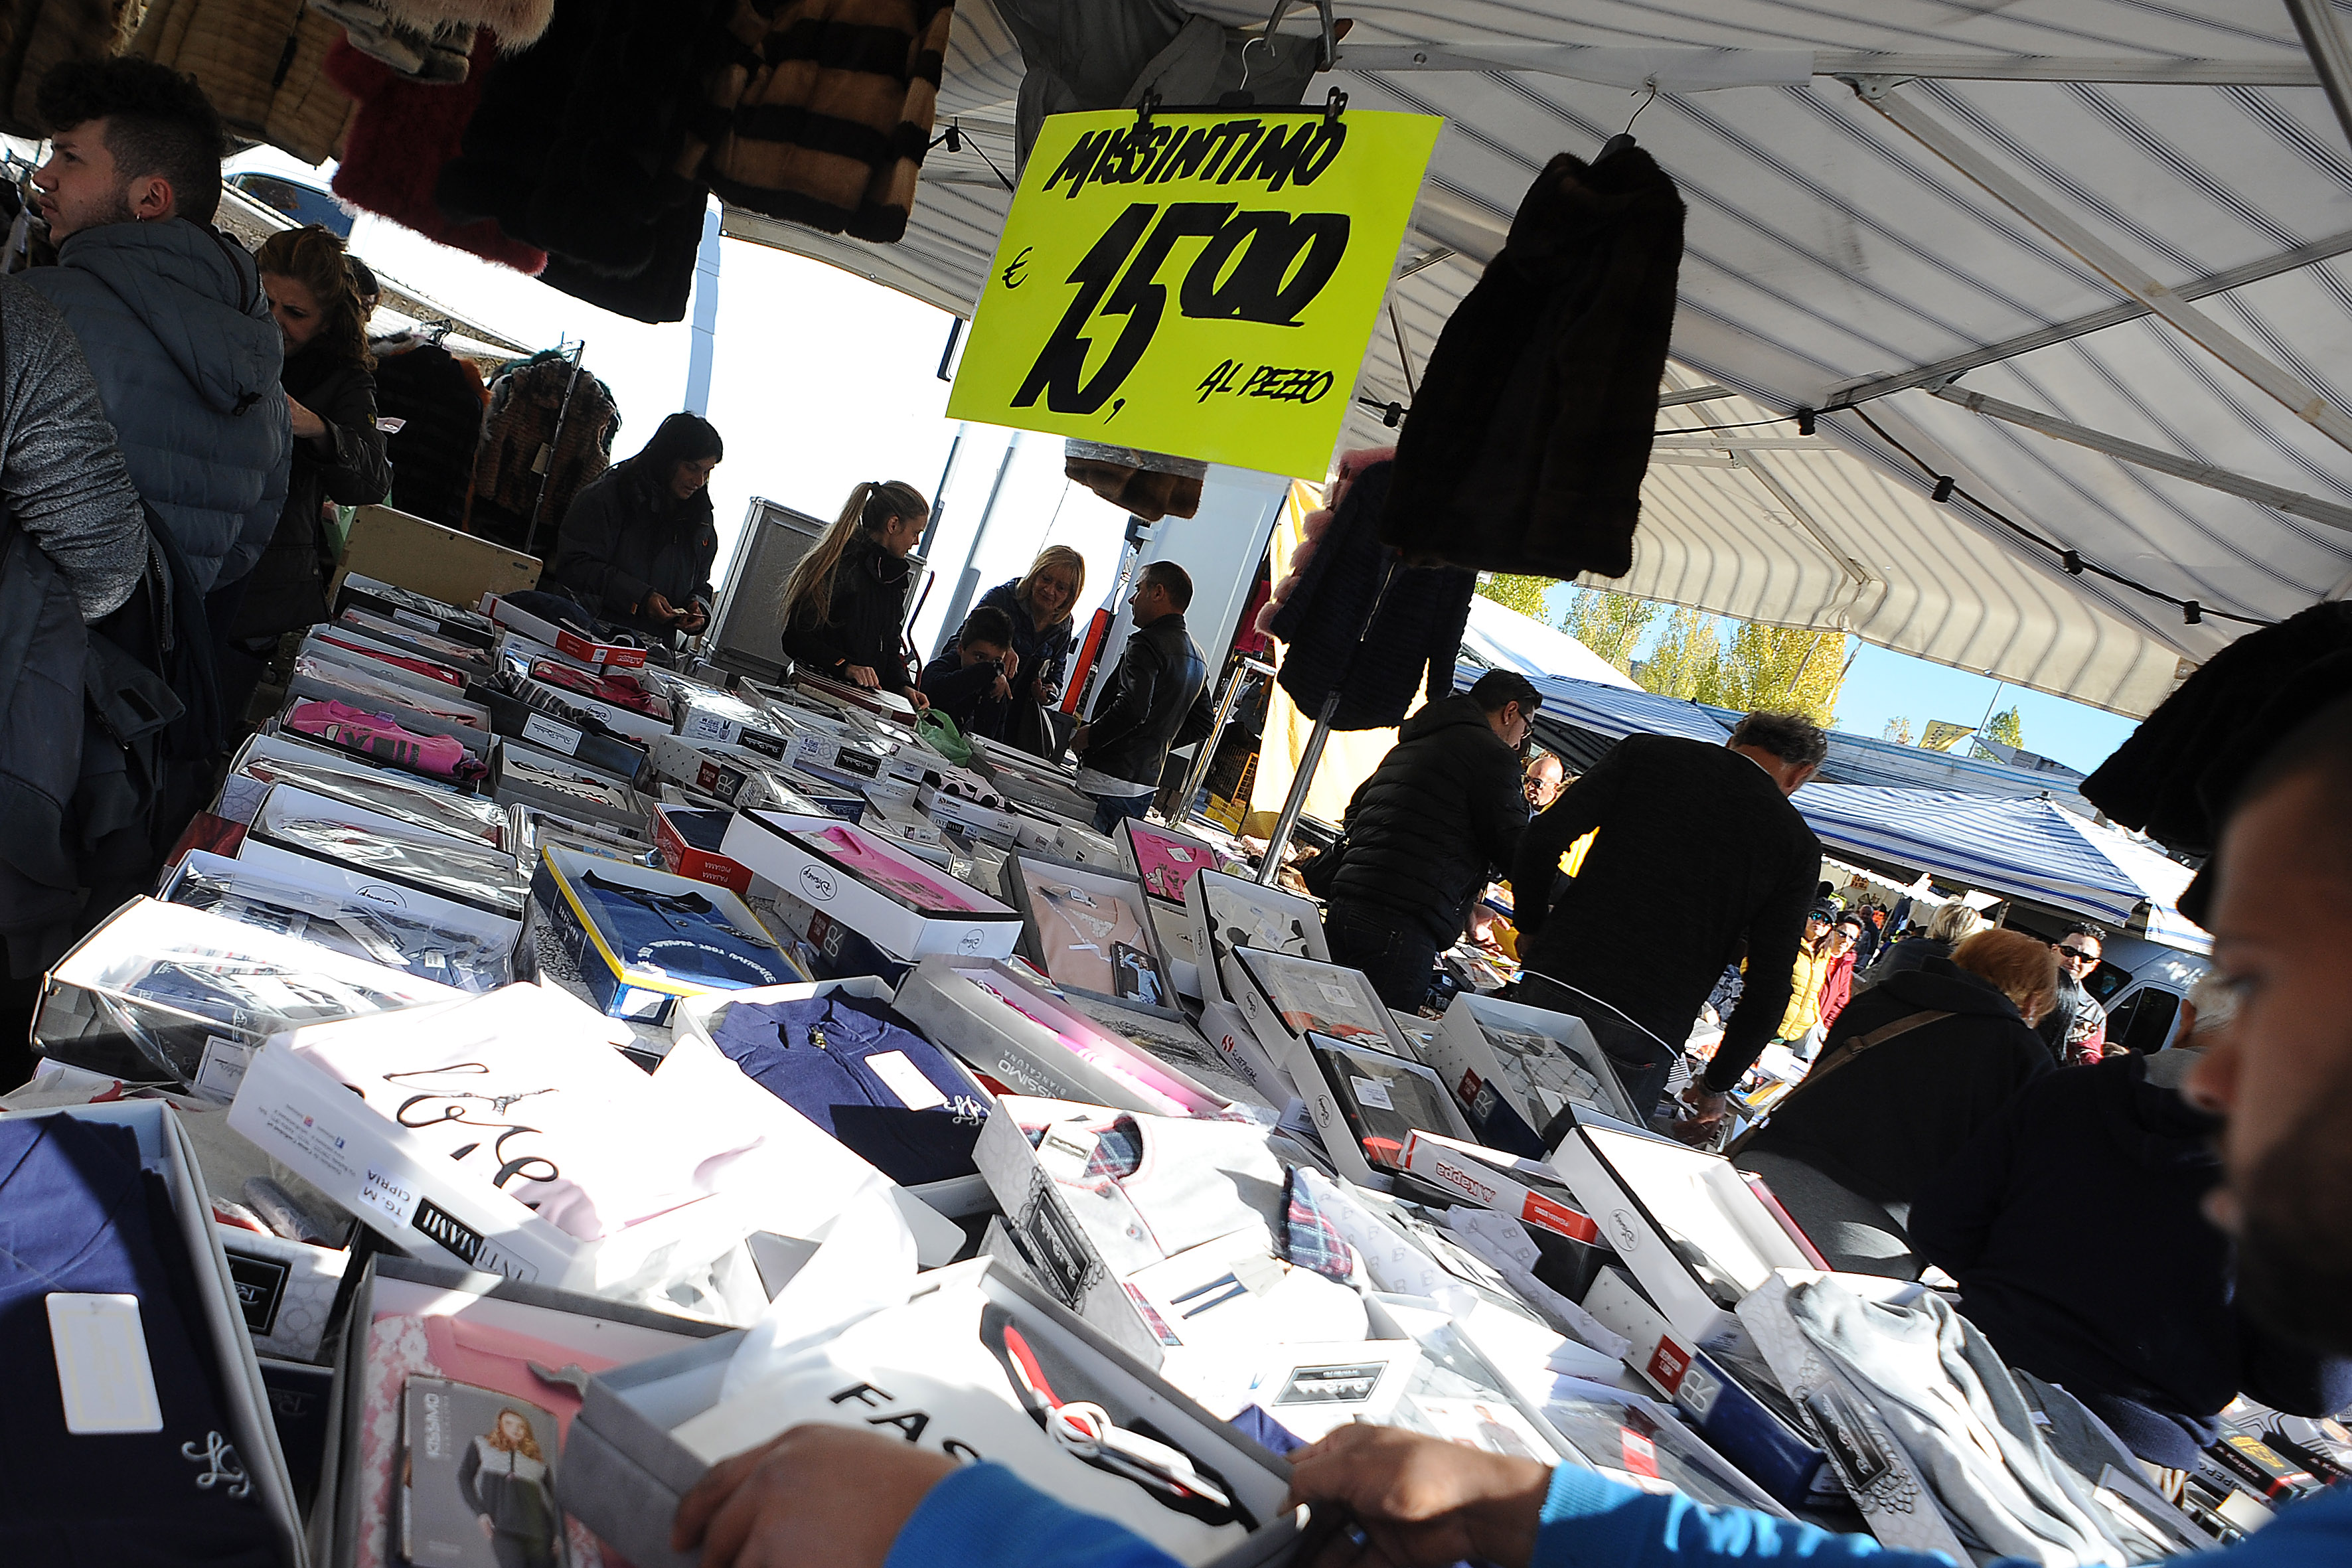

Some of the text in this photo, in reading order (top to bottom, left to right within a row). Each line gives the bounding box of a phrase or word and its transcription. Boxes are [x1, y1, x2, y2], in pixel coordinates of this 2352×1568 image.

[1042, 117, 1347, 199] MISSINTIMO
[1000, 246, 1034, 292] €
[1197, 358, 1334, 406] AL PEZZO
[803, 868, 831, 893] Disney
[996, 1059, 1062, 1099] ISSIMO
[362, 1186, 380, 1202] M
[366, 1170, 411, 1203] CIPRIA
[1435, 1161, 1480, 1198] Kappa
